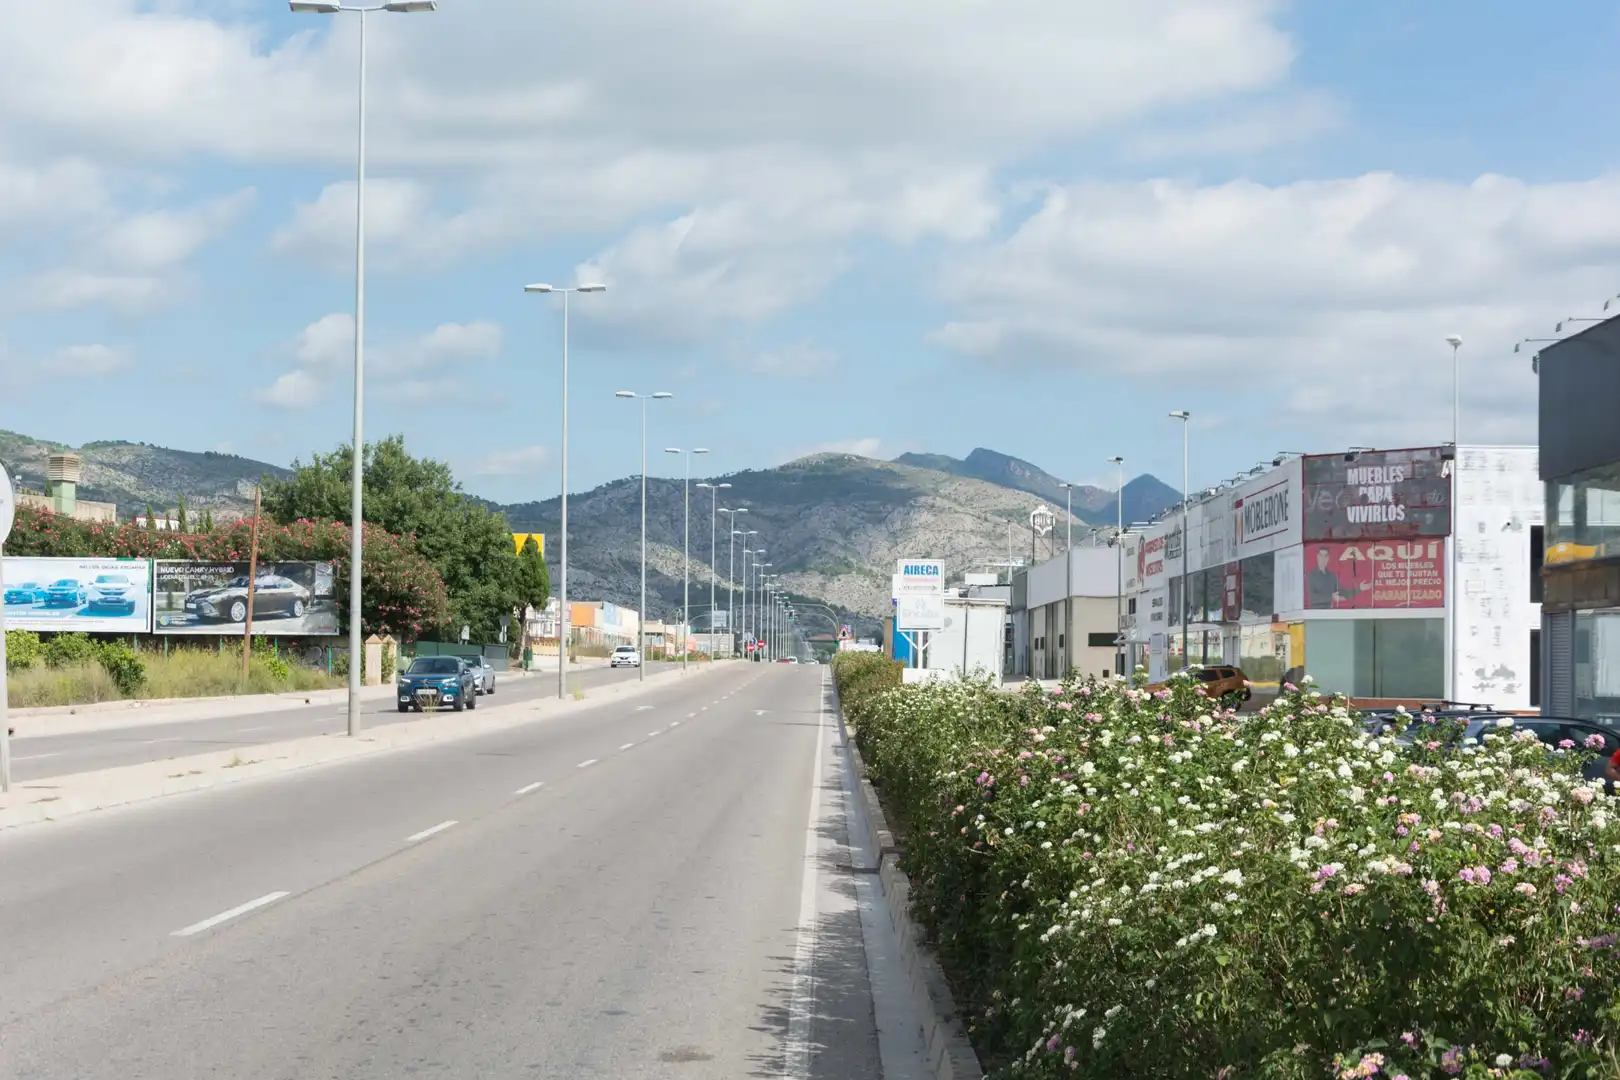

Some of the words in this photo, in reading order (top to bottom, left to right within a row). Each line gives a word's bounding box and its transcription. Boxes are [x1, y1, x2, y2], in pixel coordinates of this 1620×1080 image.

[1347, 466, 1405, 485] MUEBLES
[1244, 488, 1289, 535] MOBLERONE
[1347, 504, 1406, 524] VIVIRLOS
[1339, 540, 1444, 561] AQUÍ
[903, 564, 939, 576] AIRECA
[1381, 562, 1397, 570] LOS
[1385, 578, 1410, 586] MEJO
